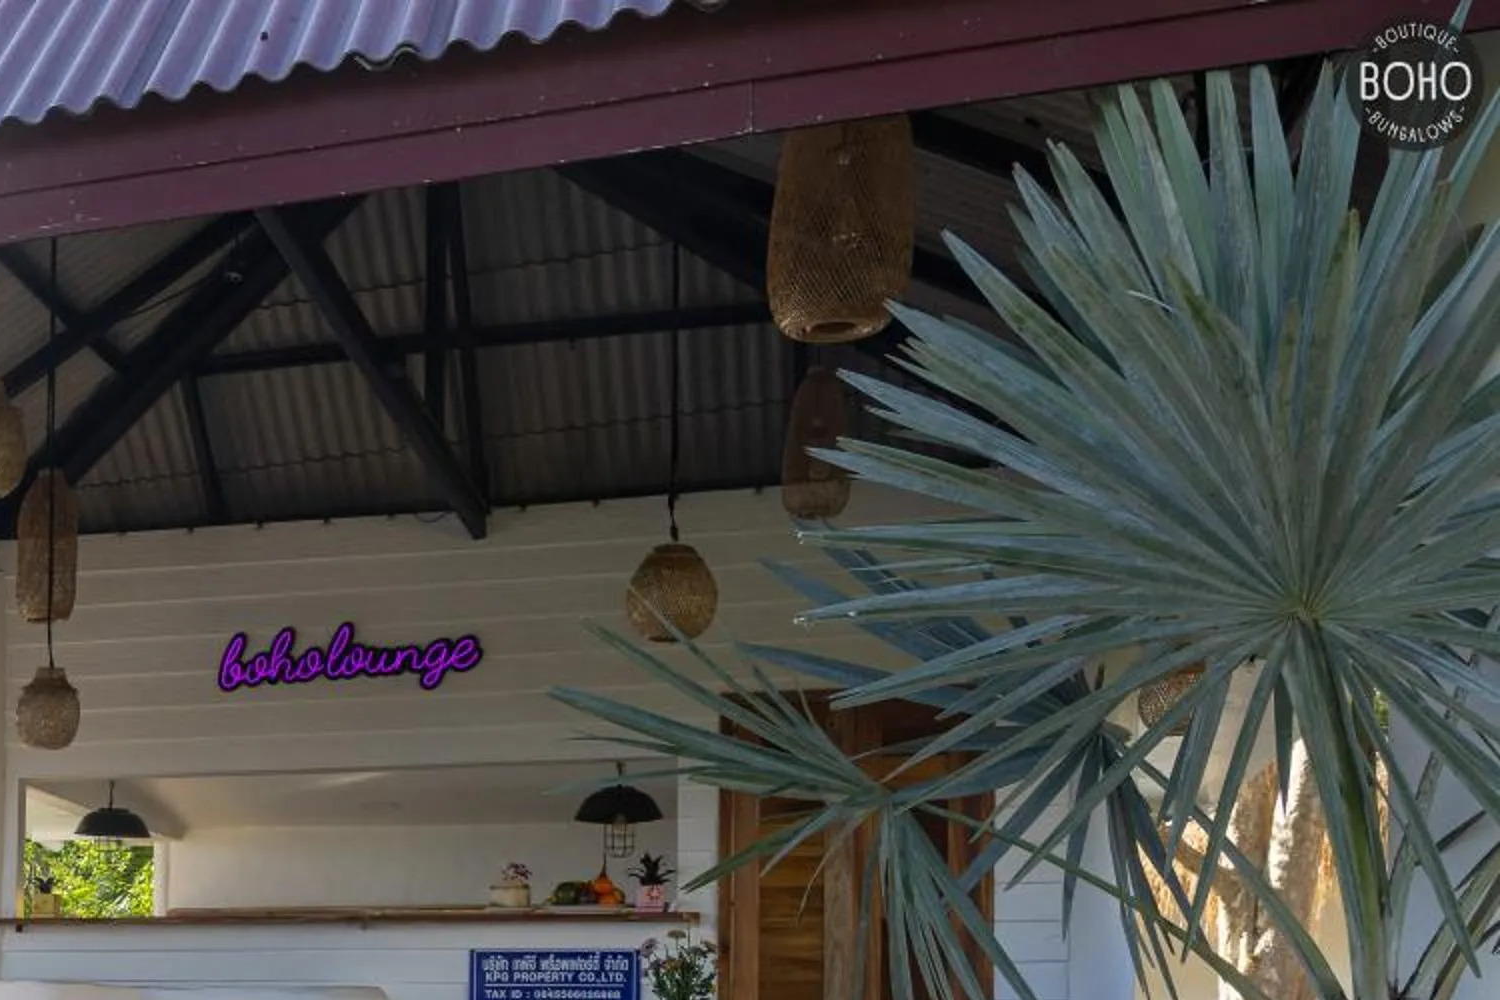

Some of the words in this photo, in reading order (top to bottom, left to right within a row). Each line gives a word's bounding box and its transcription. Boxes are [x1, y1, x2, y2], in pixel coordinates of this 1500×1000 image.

[513, 971, 573, 982] PROPERTY
[484, 989, 506, 999] TAX
[511, 989, 523, 999] ID
